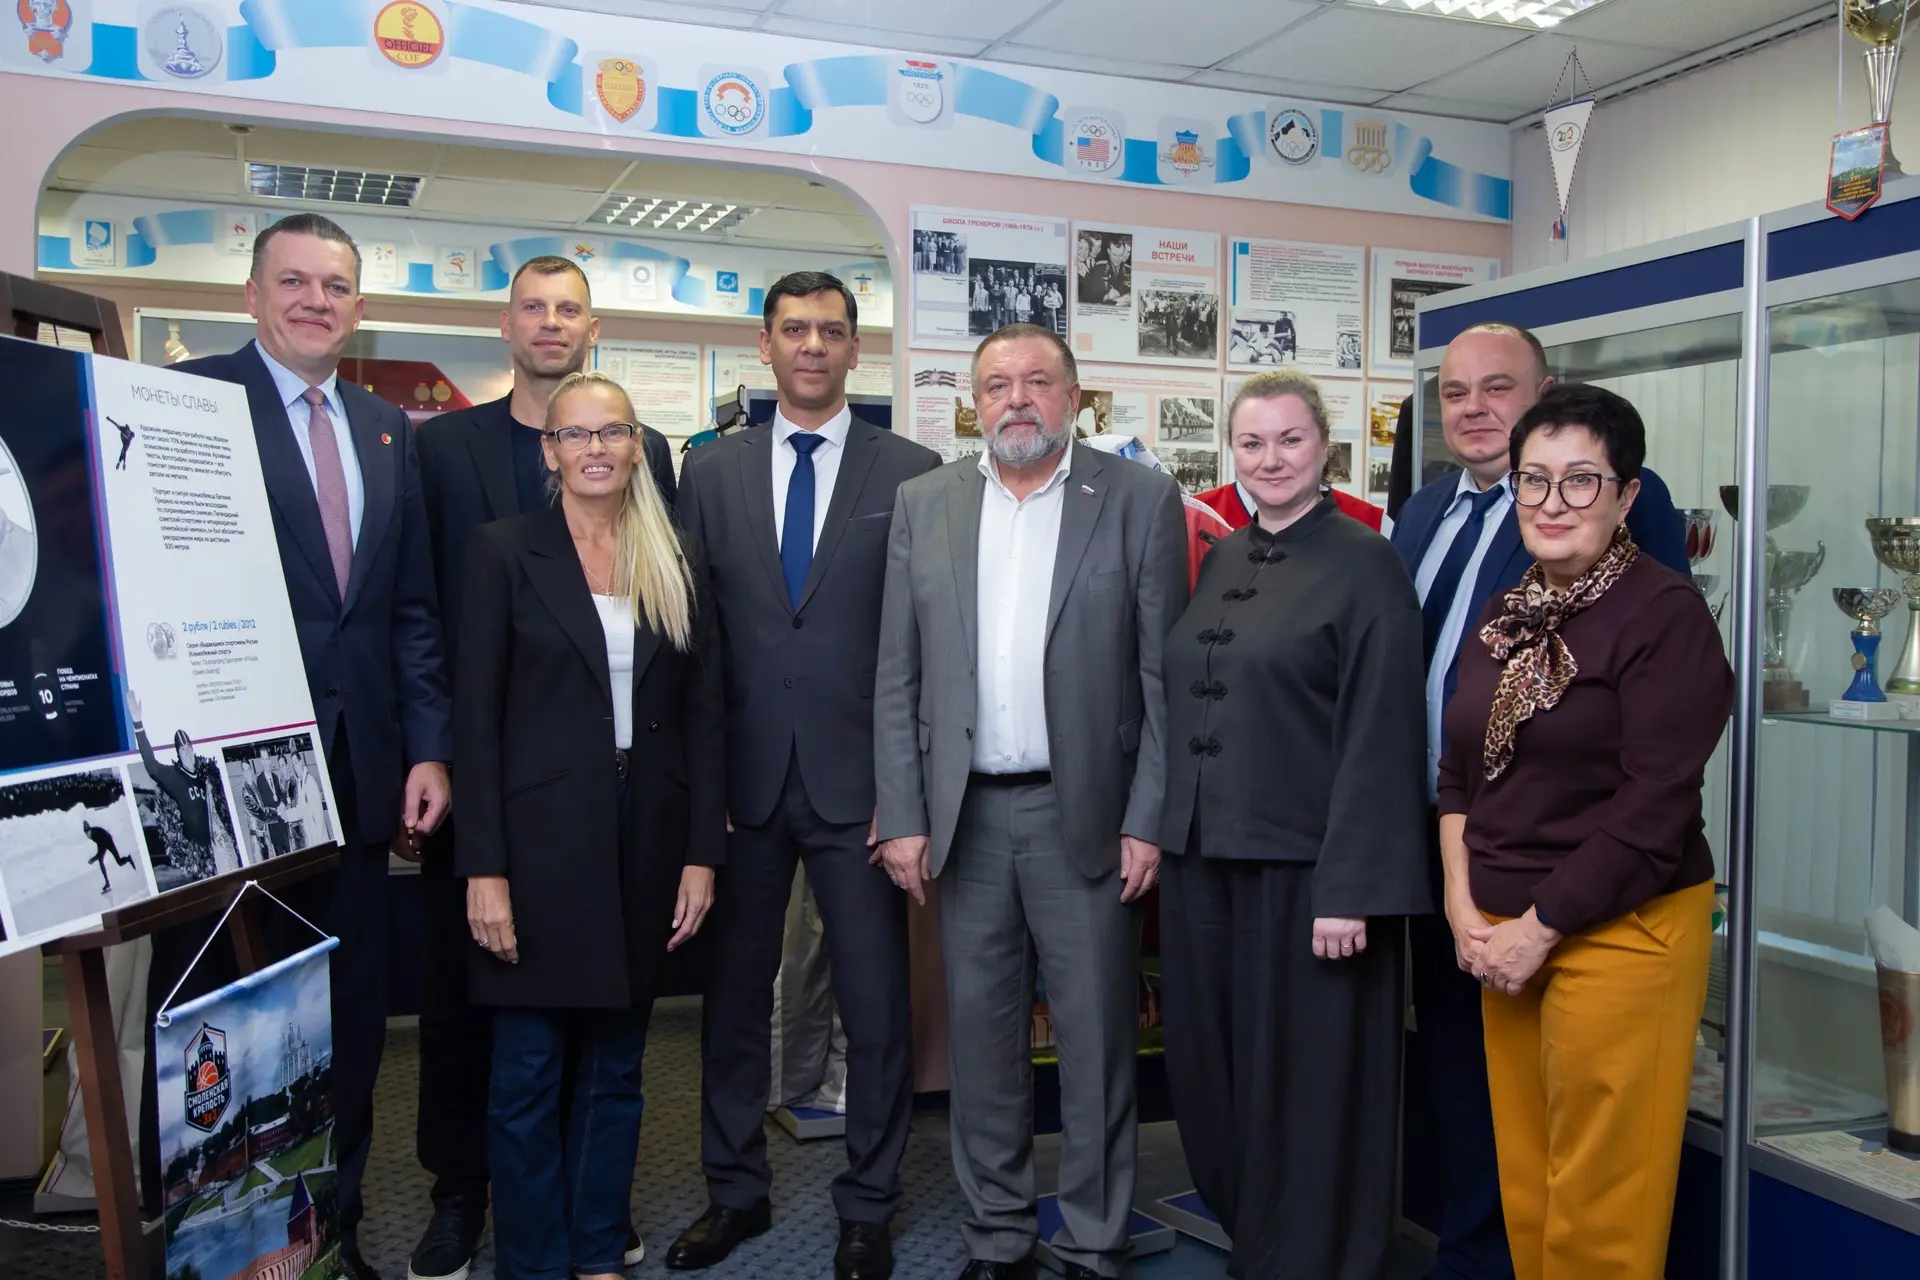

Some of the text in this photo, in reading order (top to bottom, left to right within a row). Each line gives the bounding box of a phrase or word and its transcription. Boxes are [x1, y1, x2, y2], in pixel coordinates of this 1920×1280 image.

[384, 38, 433, 53] OFFICIEL
[942, 217, 967, 226] ШКОЛА
[968, 219, 1001, 229] ТРЕНЕРОВ
[1159, 240, 1188, 251] НАШИ
[131, 384, 219, 413] МОНЕТЫ СЛАВЫ
[164, 542, 174, 550] 500
[182, 619, 257, 635] 2 рубля 2 rubles 2012
[38, 689, 54, 705] 10
[188, 1079, 229, 1109] СМОЛЕНСКАЯ
[193, 1093, 226, 1118] КРЕПОСТЬ
